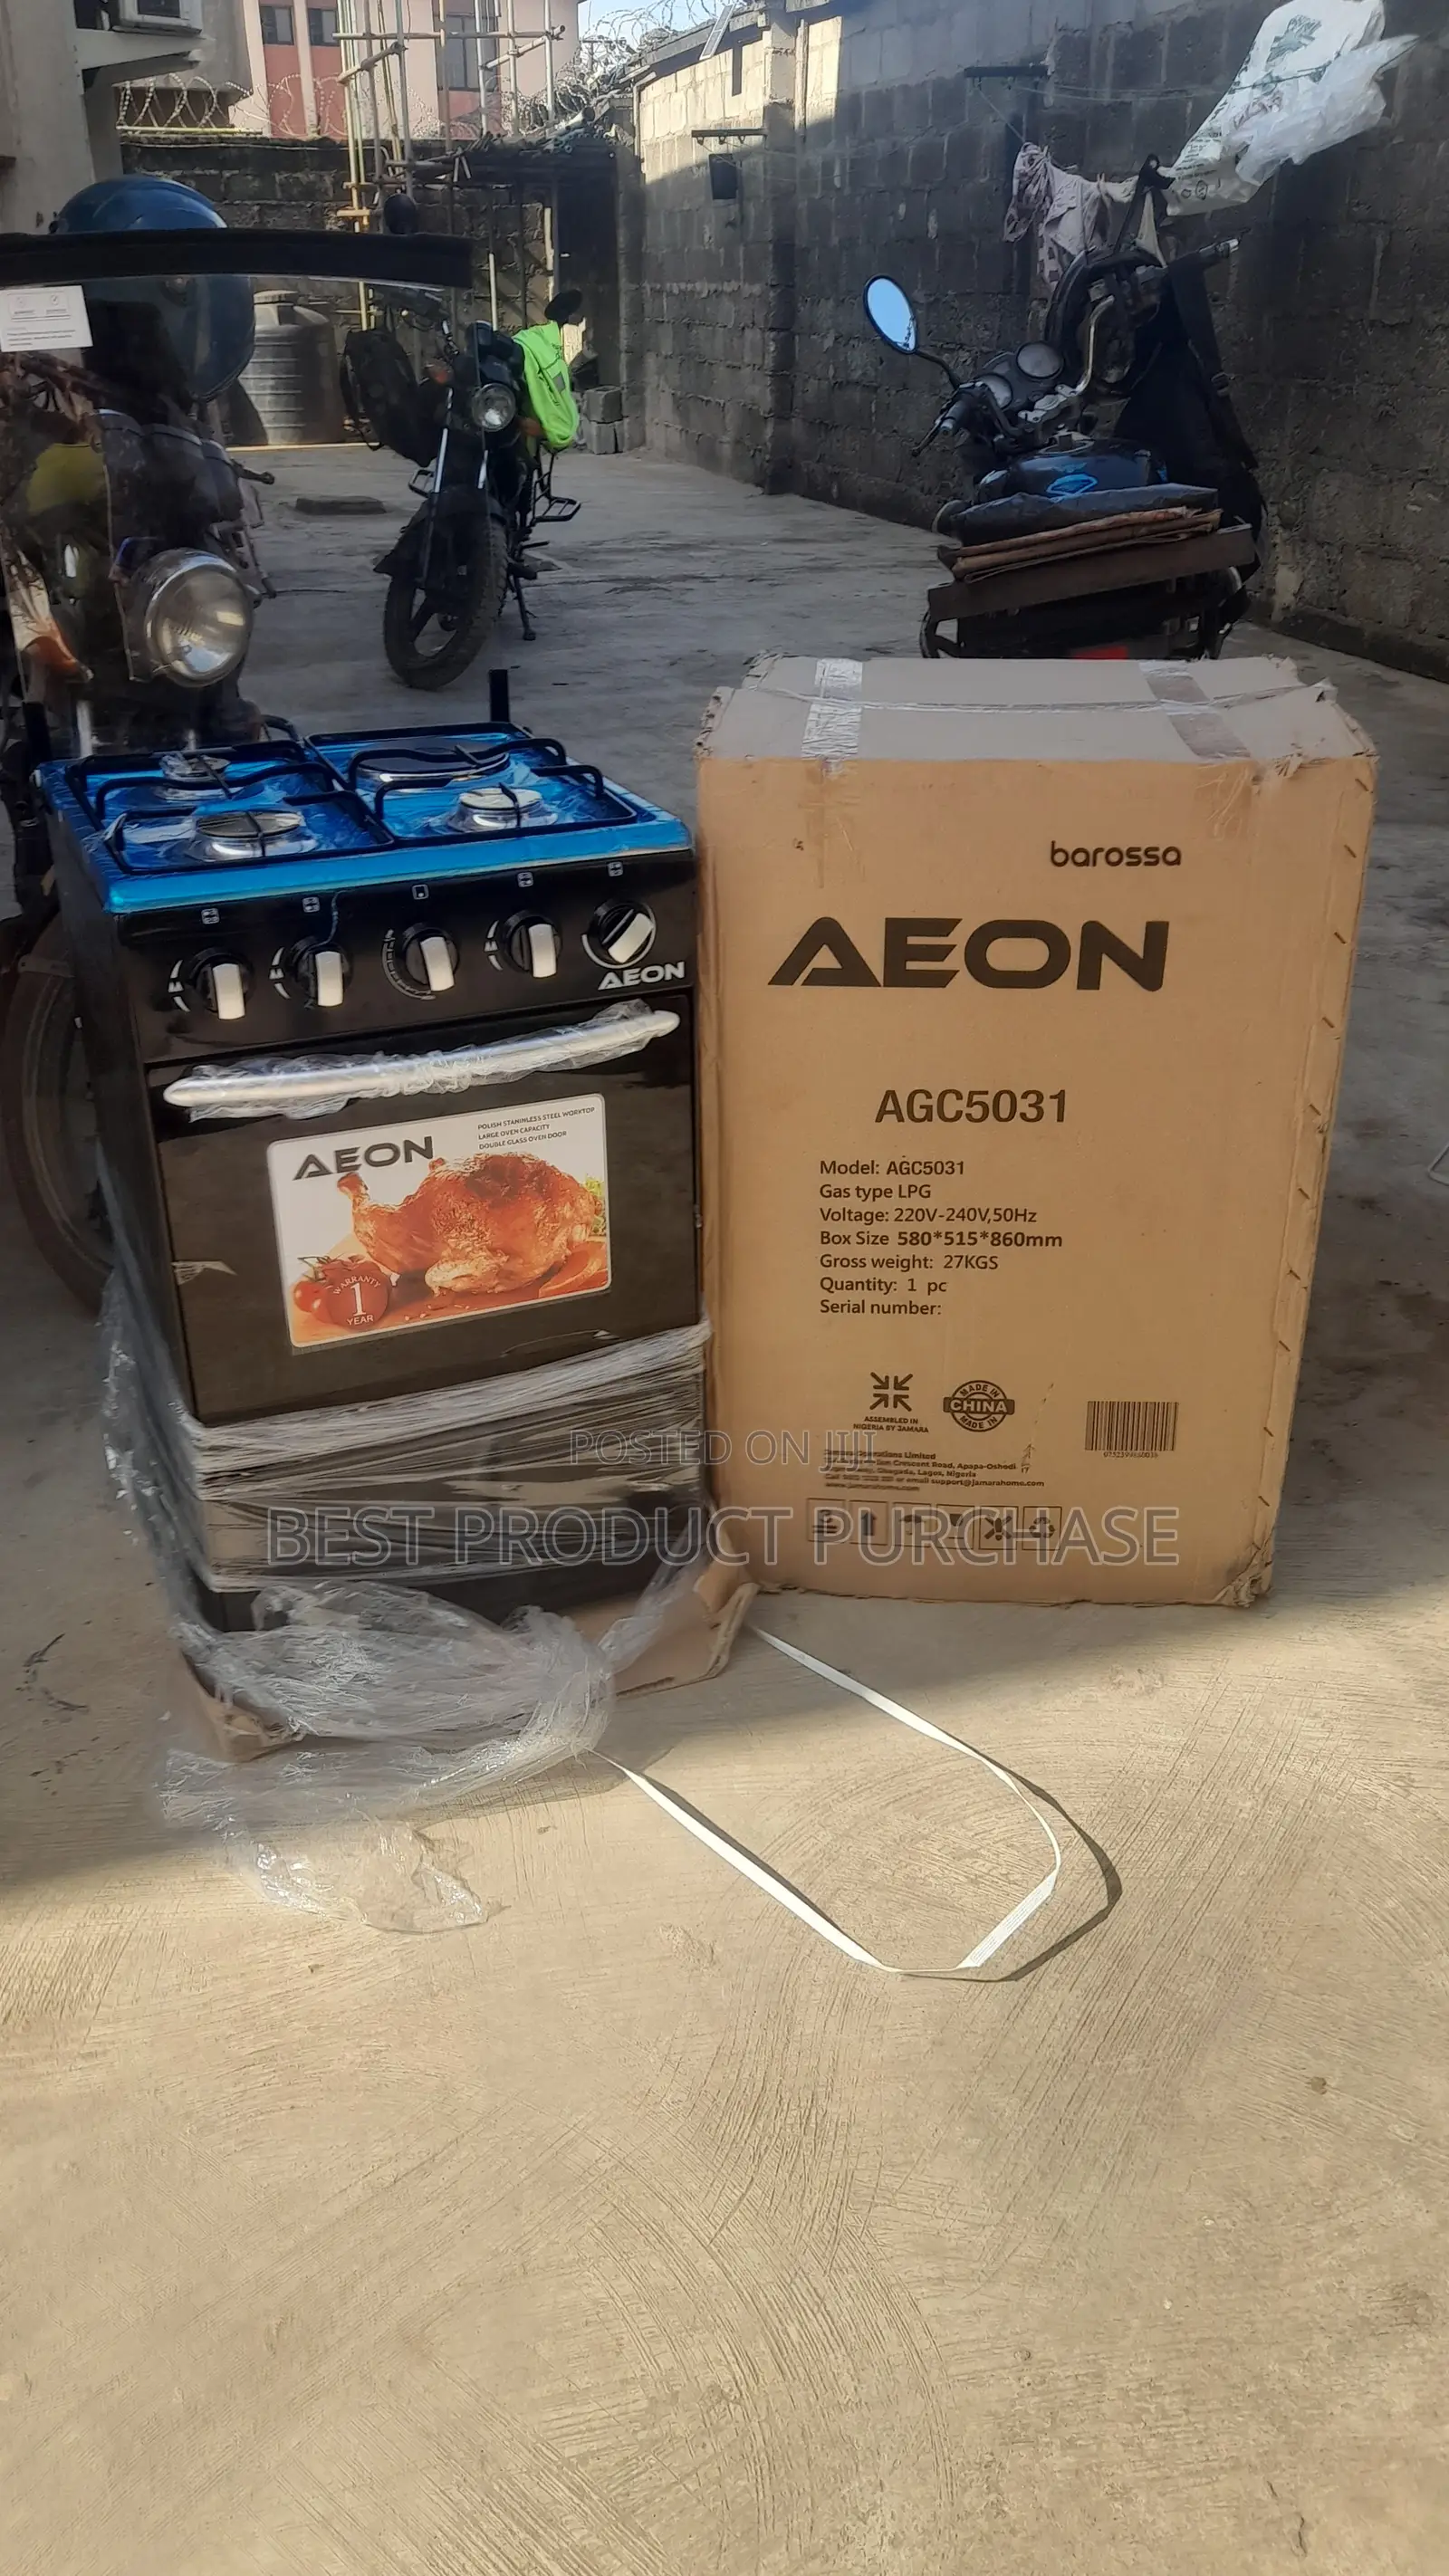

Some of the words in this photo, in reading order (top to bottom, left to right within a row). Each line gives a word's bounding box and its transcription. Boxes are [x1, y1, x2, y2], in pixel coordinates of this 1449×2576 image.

[1050, 840, 1182, 867] barossa
[767, 916, 1170, 991] AEON
[598, 962, 686, 991] AEON
[542, 1112, 561, 1121] STEEL
[561, 1106, 595, 1117] WORKTOP
[875, 1088, 1066, 1123] AGC5031
[478, 1131, 499, 1140] LARGE
[500, 1129, 519, 1137] OVEN
[520, 1124, 550, 1135] CAPACITY
[479, 1140, 505, 1150] DOUBLE
[506, 1137, 528, 1145] GLASS
[528, 1135, 546, 1143] OVEN
[547, 1131, 567, 1139] DOOR
[293, 1136, 433, 1181] AEON
[820, 1160, 880, 1175] Model:
[887, 1161, 964, 1175] AGC5031
[820, 1184, 850, 1199] Gas
[855, 1186, 893, 1202] type
[898, 1184, 931, 1199] LPG
[820, 1208, 889, 1225] Voltage:
[894, 1208, 1037, 1224] 220V-240V,50Hz
[820, 1231, 852, 1245] Box
[856, 1231, 889, 1245] Size
[820, 1254, 867, 1269] Gross
[871, 1254, 934, 1272] weight:
[944, 1255, 999, 1269] 27KGS
[333, 1275, 381, 1294] WARRANTY
[820, 1277, 897, 1295] Quantity:
[907, 1278, 916, 1291] 1
[927, 1280, 947, 1295] pc
[350, 1282, 366, 1317] 1
[820, 1299, 865, 1314] Serial
[870, 1300, 942, 1315] number:
[347, 1315, 374, 1326] YEAR
[960, 1384, 988, 1397] MADE
[990, 1387, 1000, 1397] IN
[951, 1399, 1007, 1412] CHINA
[864, 1416, 908, 1424] ASSEMBLED
[960, 1415, 984, 1429] MADE
[989, 1416, 998, 1426] IN
[904, 1451, 936, 1460] Limited
[893, 1460, 930, 1469] Crescent
[932, 1461, 955, 1470] Road,
[957, 1462, 1016, 1471] Apapa-Oshodi
[907, 1476, 930, 1484] email
[931, 1478, 1045, 1488] support@jamarahome.com
[917, 1470, 944, 1478] Lagos,
[946, 1470, 976, 1479] Nigeria
